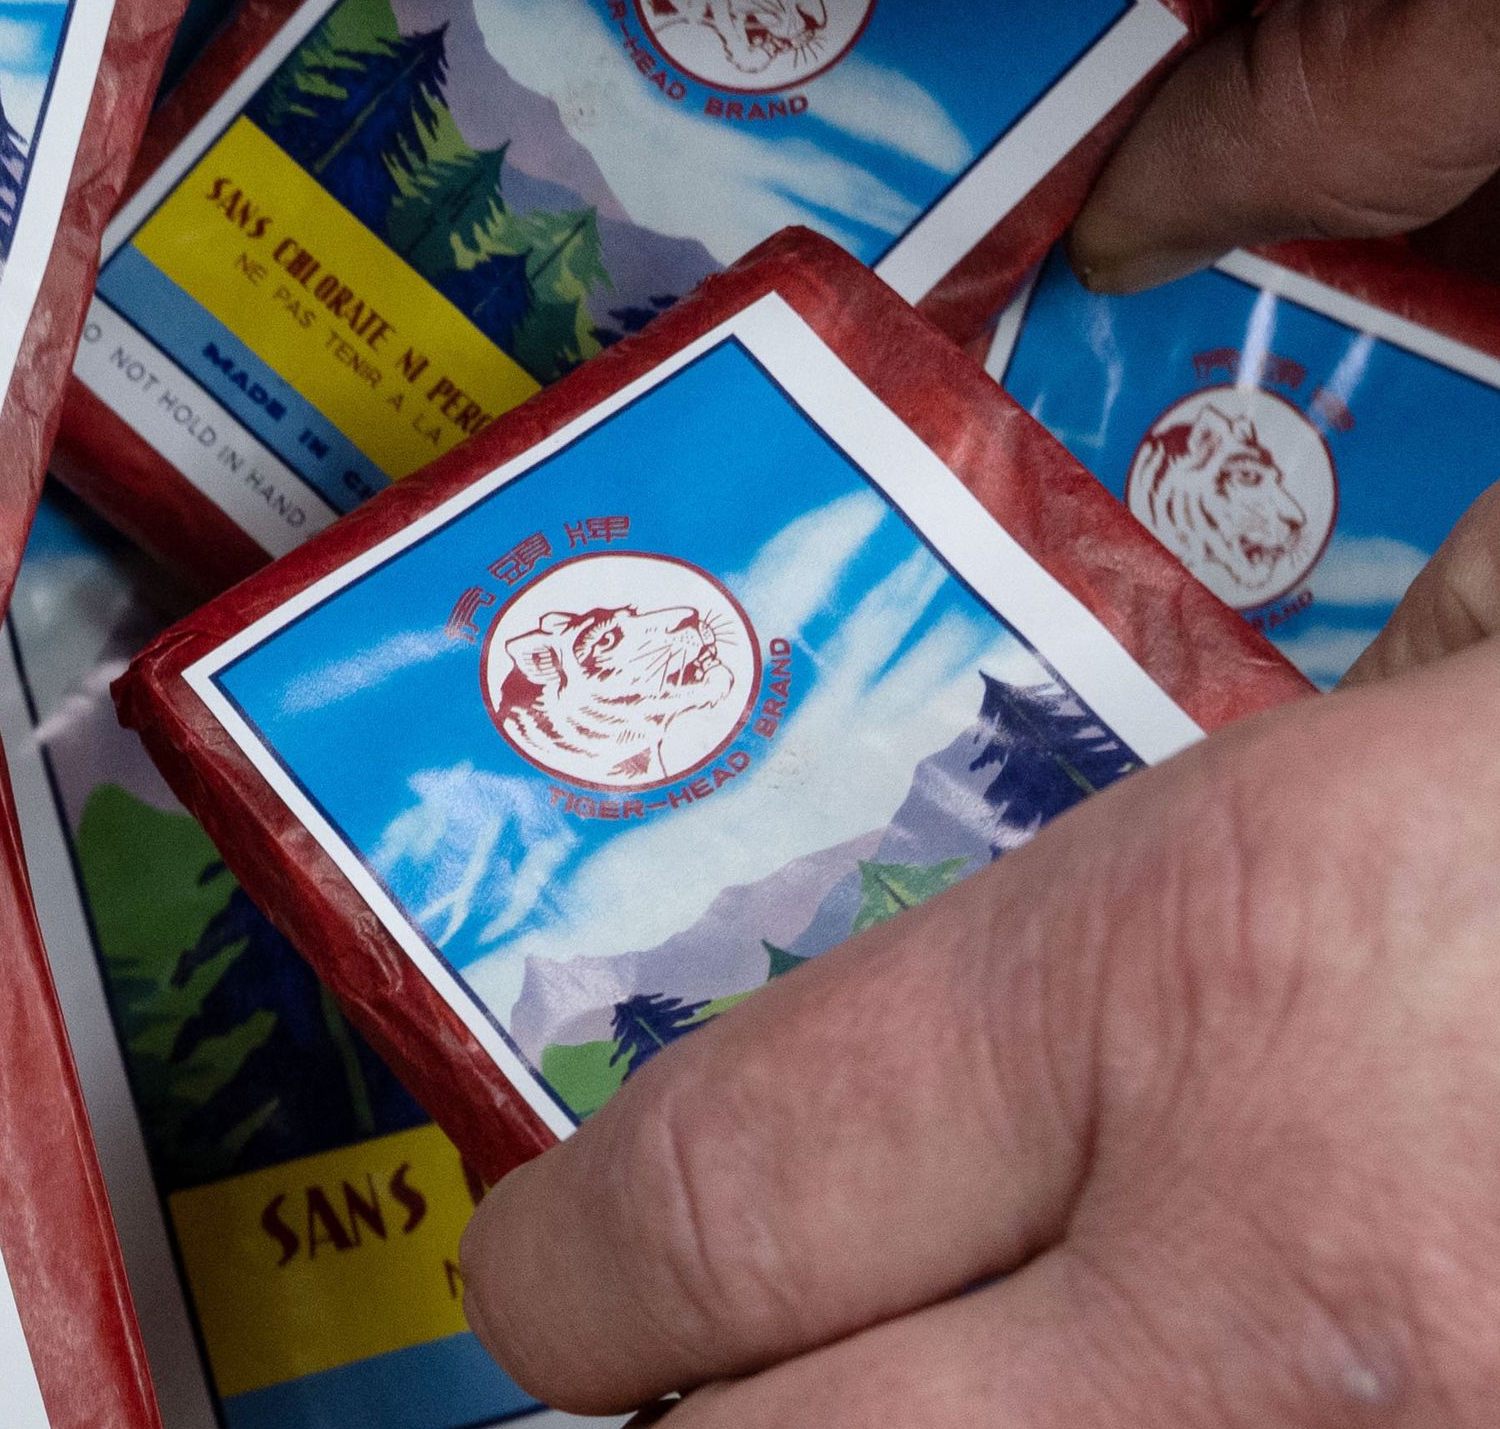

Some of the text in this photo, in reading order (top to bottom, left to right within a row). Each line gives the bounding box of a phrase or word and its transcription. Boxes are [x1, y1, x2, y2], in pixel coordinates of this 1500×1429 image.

[703, 94, 808, 122] BRAND
[206, 176, 431, 384] SANS CHLORATE NI
[233, 251, 269, 284] NE
[273, 285, 317, 330] PAS
[325, 330, 384, 390] TENIR
[387, 392, 405, 413] A
[412, 405, 444, 446] LA
[109, 346, 160, 395] NOT
[158, 391, 217, 448] HOLD
[217, 443, 244, 473] IN
[245, 470, 307, 529] HAND
[202, 343, 332, 460] MADE IN
[1253, 589, 1314, 634] RAND
[548, 637, 792, 820] TIGER-HEAD BRAND
[260, 1162, 427, 1267] SANS
